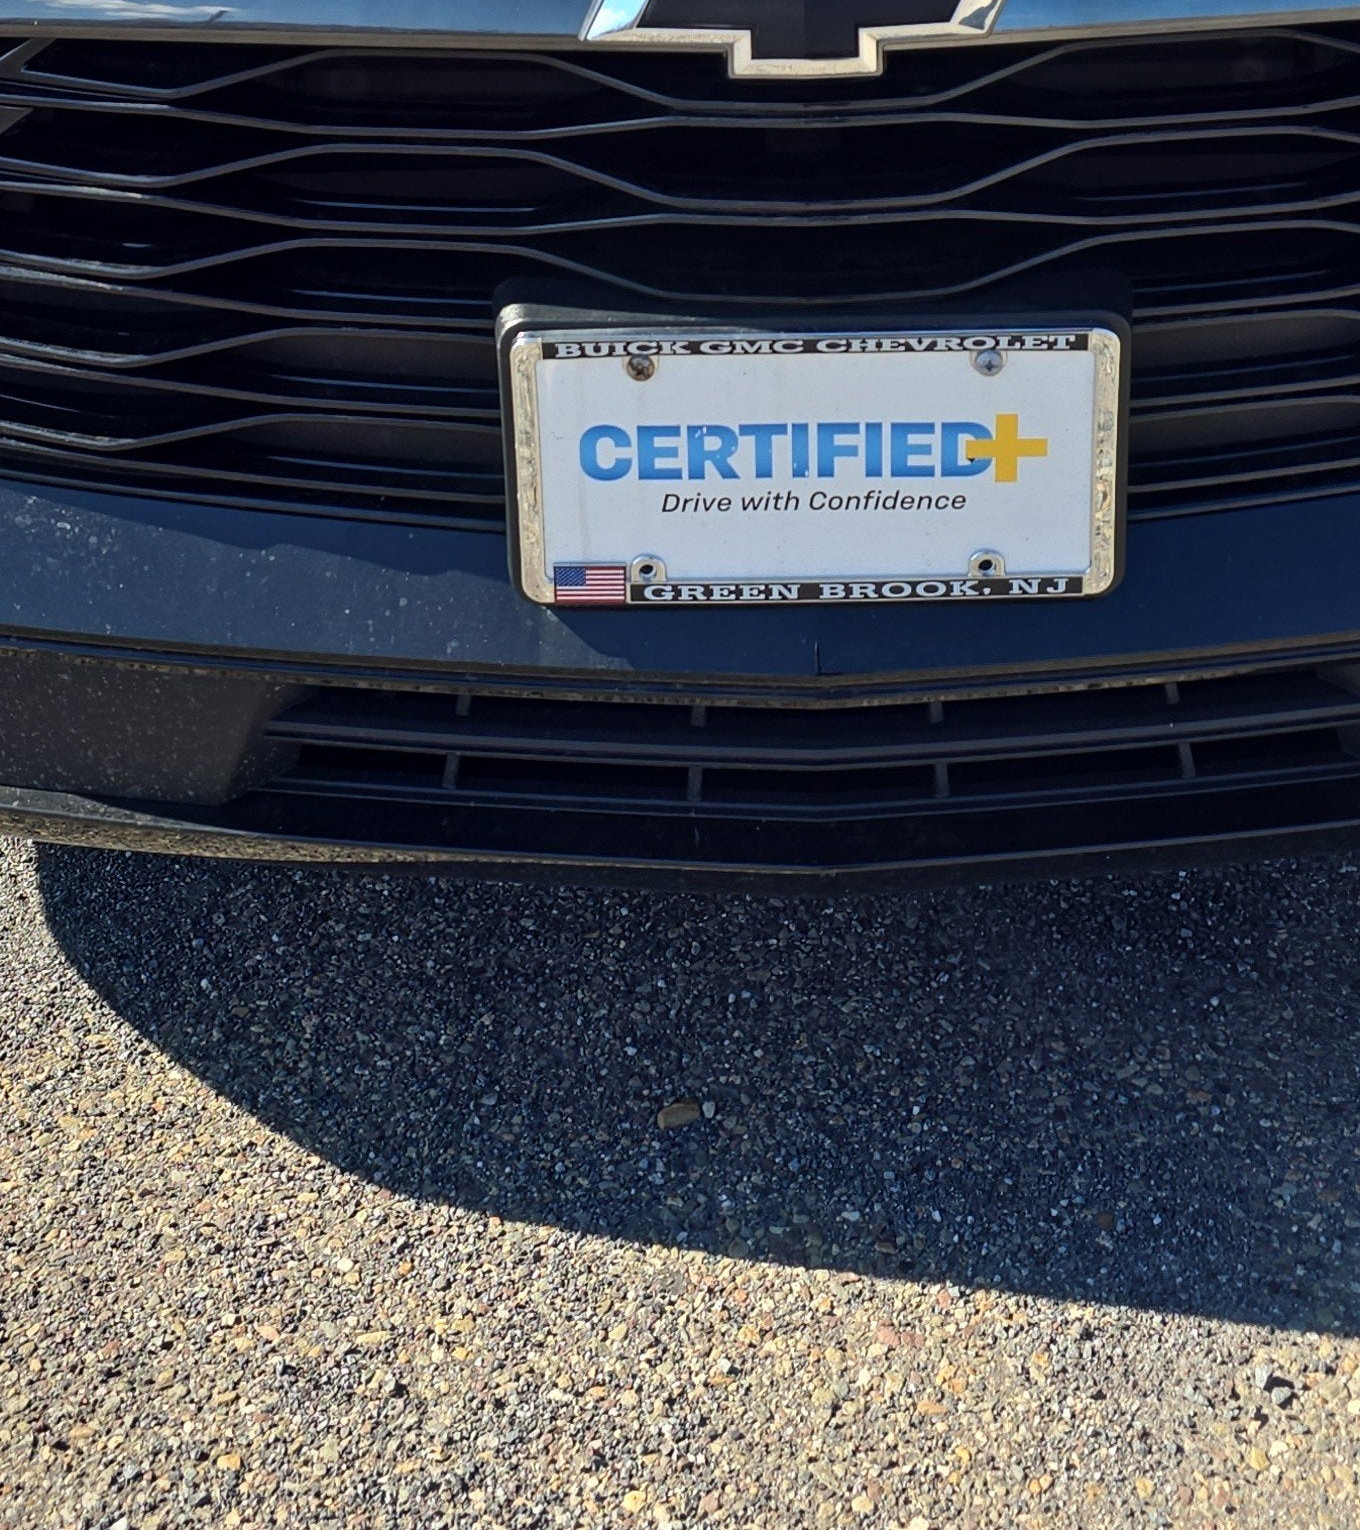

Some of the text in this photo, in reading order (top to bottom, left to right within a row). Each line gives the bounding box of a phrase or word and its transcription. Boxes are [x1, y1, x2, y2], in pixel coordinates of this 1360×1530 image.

[554, 334, 1077, 358] BUICK GMC CHEVROLET
[661, 489, 967, 513] Drive with Confidence
[643, 583, 802, 602] GREEN
[818, 579, 993, 600] BROOK,
